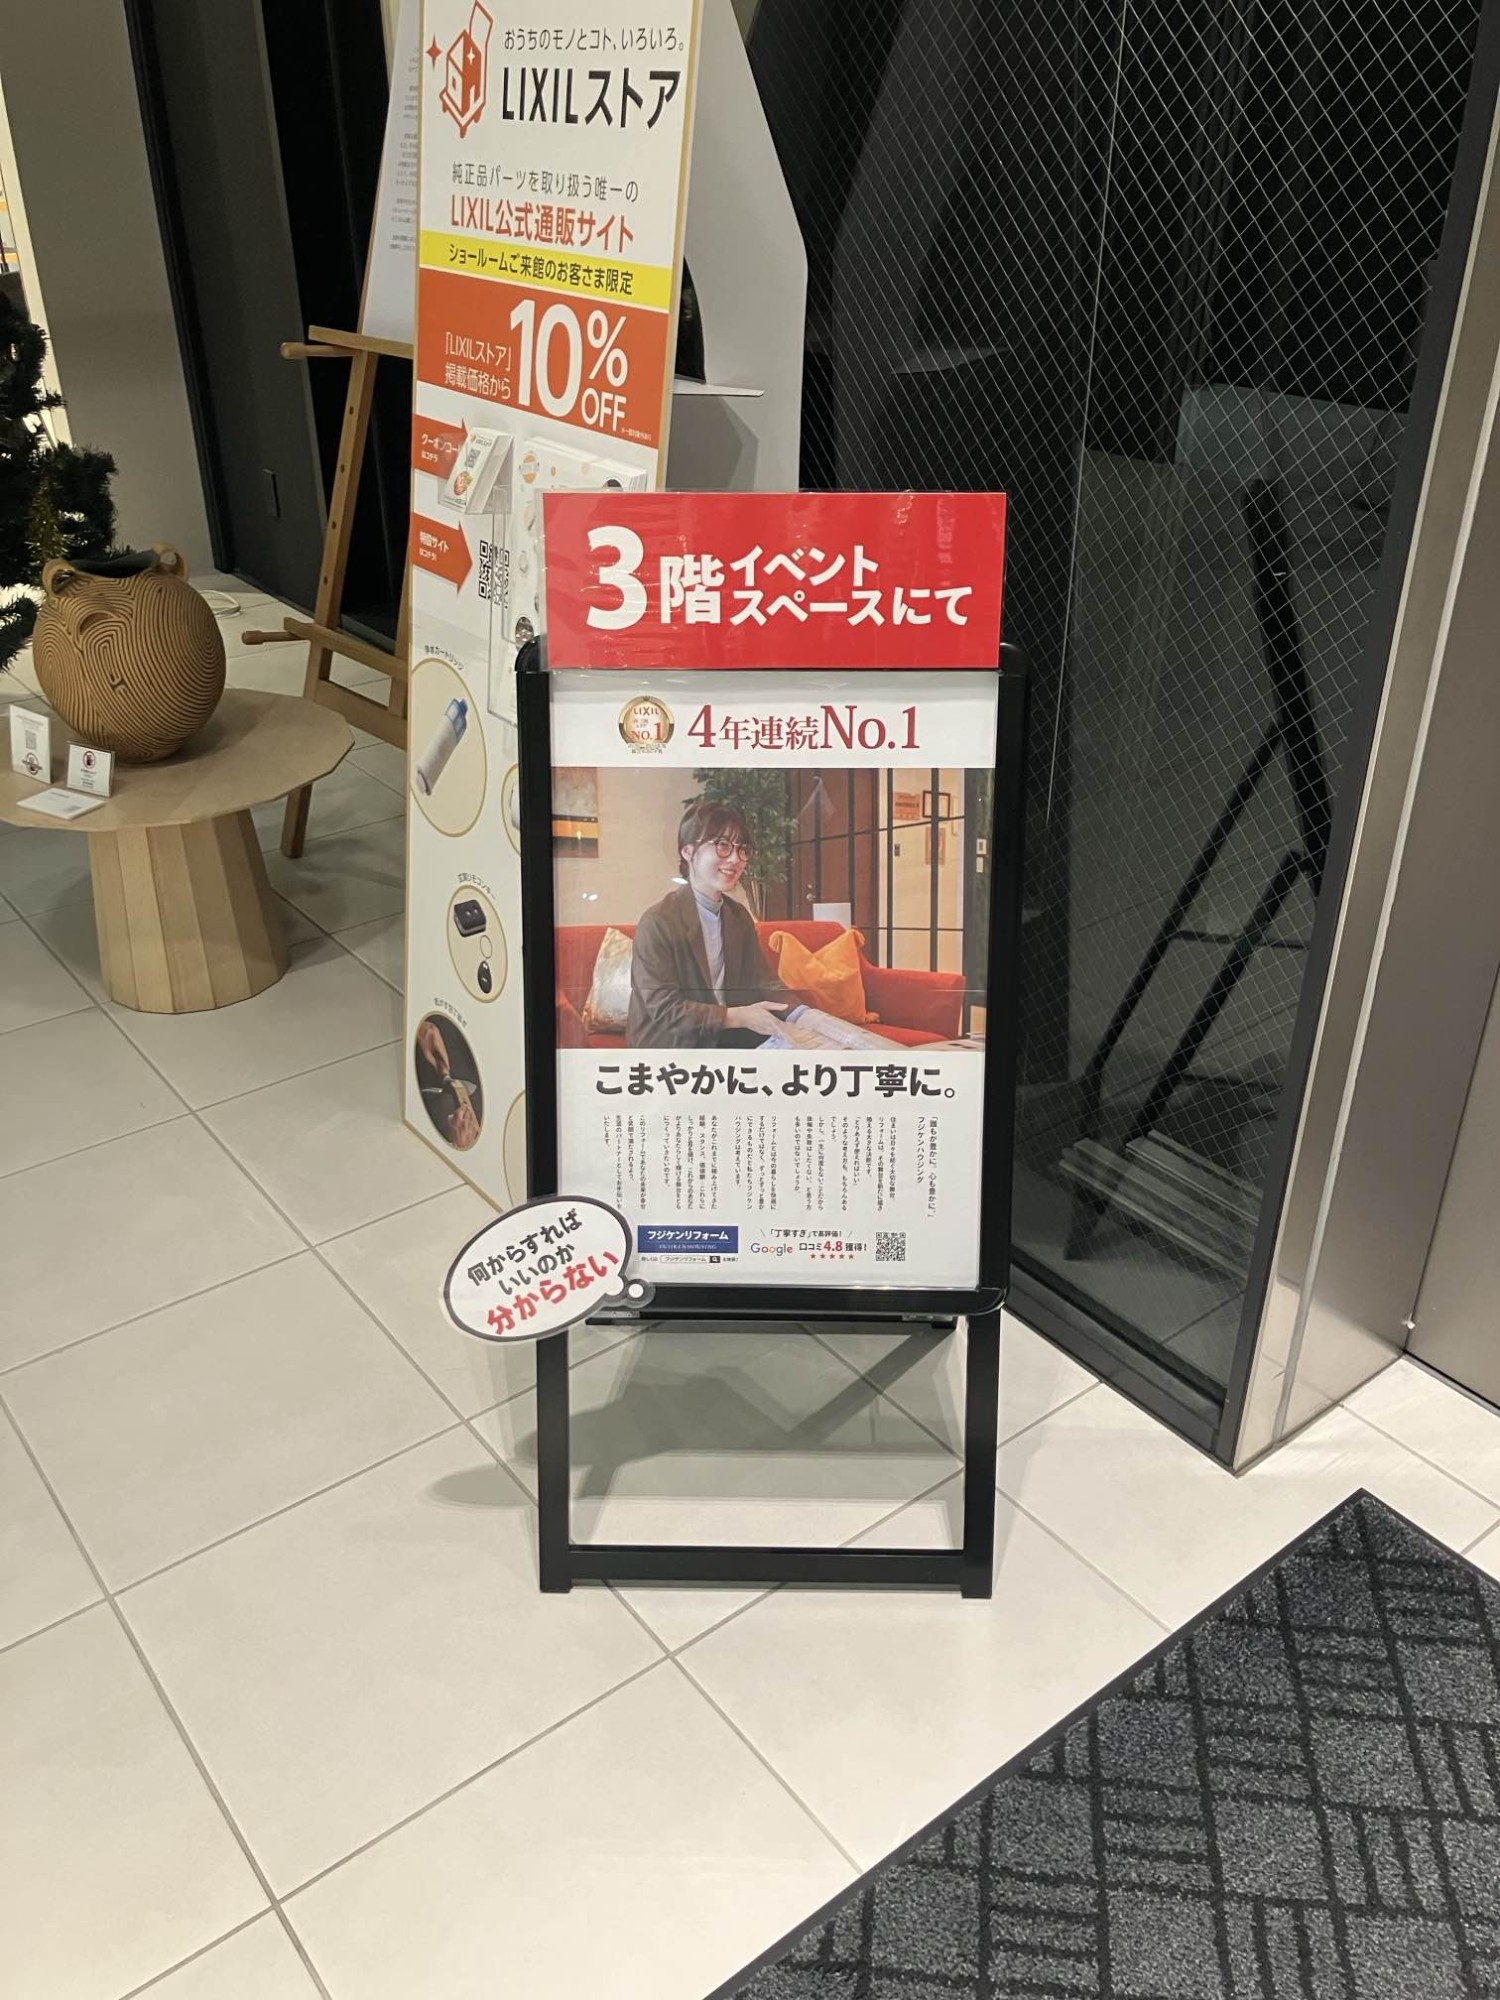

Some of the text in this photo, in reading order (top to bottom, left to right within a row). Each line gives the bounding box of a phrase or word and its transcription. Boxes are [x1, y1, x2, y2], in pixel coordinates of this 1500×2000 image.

[504, 26, 685, 52] おうちのモノとコト、いろいろ。
[502, 66, 682, 129] LIXILストア
[451, 162, 639, 202] 純正品パーツを取り扱う唯一の
[450, 194, 635, 253] LIXIL公式通販サイト
[449, 243, 634, 295] ショールームご来館のお客さま限定
[445, 331, 512, 371] 「LIXILストア」
[510, 298, 629, 418] 10%
[445, 362, 511, 400] 掲載価格から
[581, 387, 627, 431] OFF
[586, 524, 725, 630] 3階
[730, 544, 878, 587] イベント
[729, 586, 973, 627] スペースにて
[628, 721, 664, 741] NO.1
[633, 706, 660, 716] LIXIL
[687, 703, 921, 751] 4年連続No.1
[595, 1062, 958, 1099] こまやかに、より丁寧に。
[916, 1116, 926, 1184] フジケンハウジング
[467, 1207, 584, 1286] 何からすれば
[647, 1230, 729, 1240] フジケンリフォーム
[750, 1242, 793, 1257] Google
[498, 1243, 576, 1296] いいのか
[486, 1250, 620, 1335] 分からない
